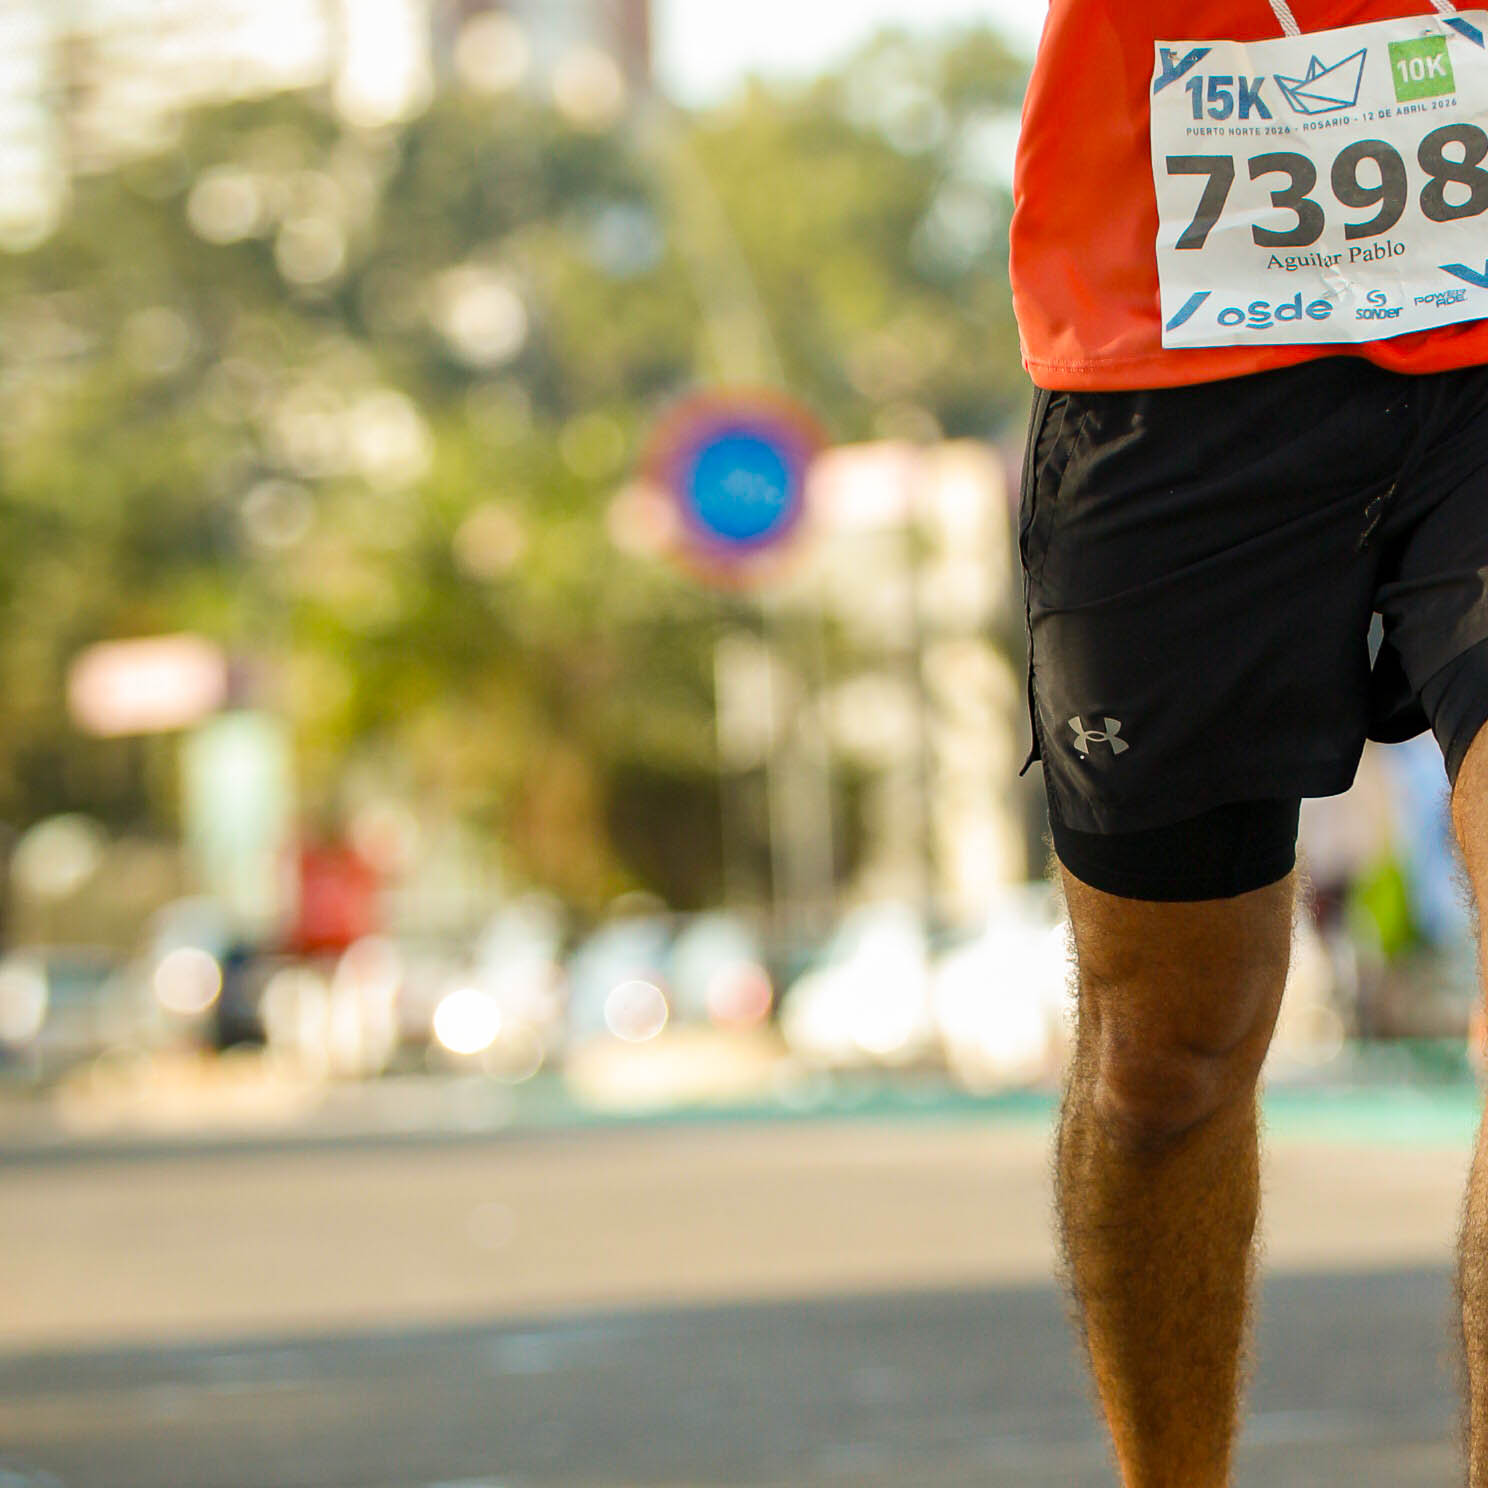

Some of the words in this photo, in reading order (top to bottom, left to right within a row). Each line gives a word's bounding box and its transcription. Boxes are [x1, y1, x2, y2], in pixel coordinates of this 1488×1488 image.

[1396, 53, 1448, 84] 10K
[1184, 75, 1273, 121] 15K
[1186, 127, 1225, 136] PUERTO
[1228, 127, 1261, 136] NORTE
[1264, 126, 1291, 136] 2026
[1303, 116, 1350, 131] ROSARIO
[1363, 112, 1374, 121] 12
[1378, 109, 1392, 119] DE
[1396, 103, 1427, 115] ABRIL
[1431, 98, 1457, 111] 2026
[1267, 252, 1342, 271] Aguilar
[1348, 240, 1405, 264] Pablo
[1217, 291, 1333, 329] osde
